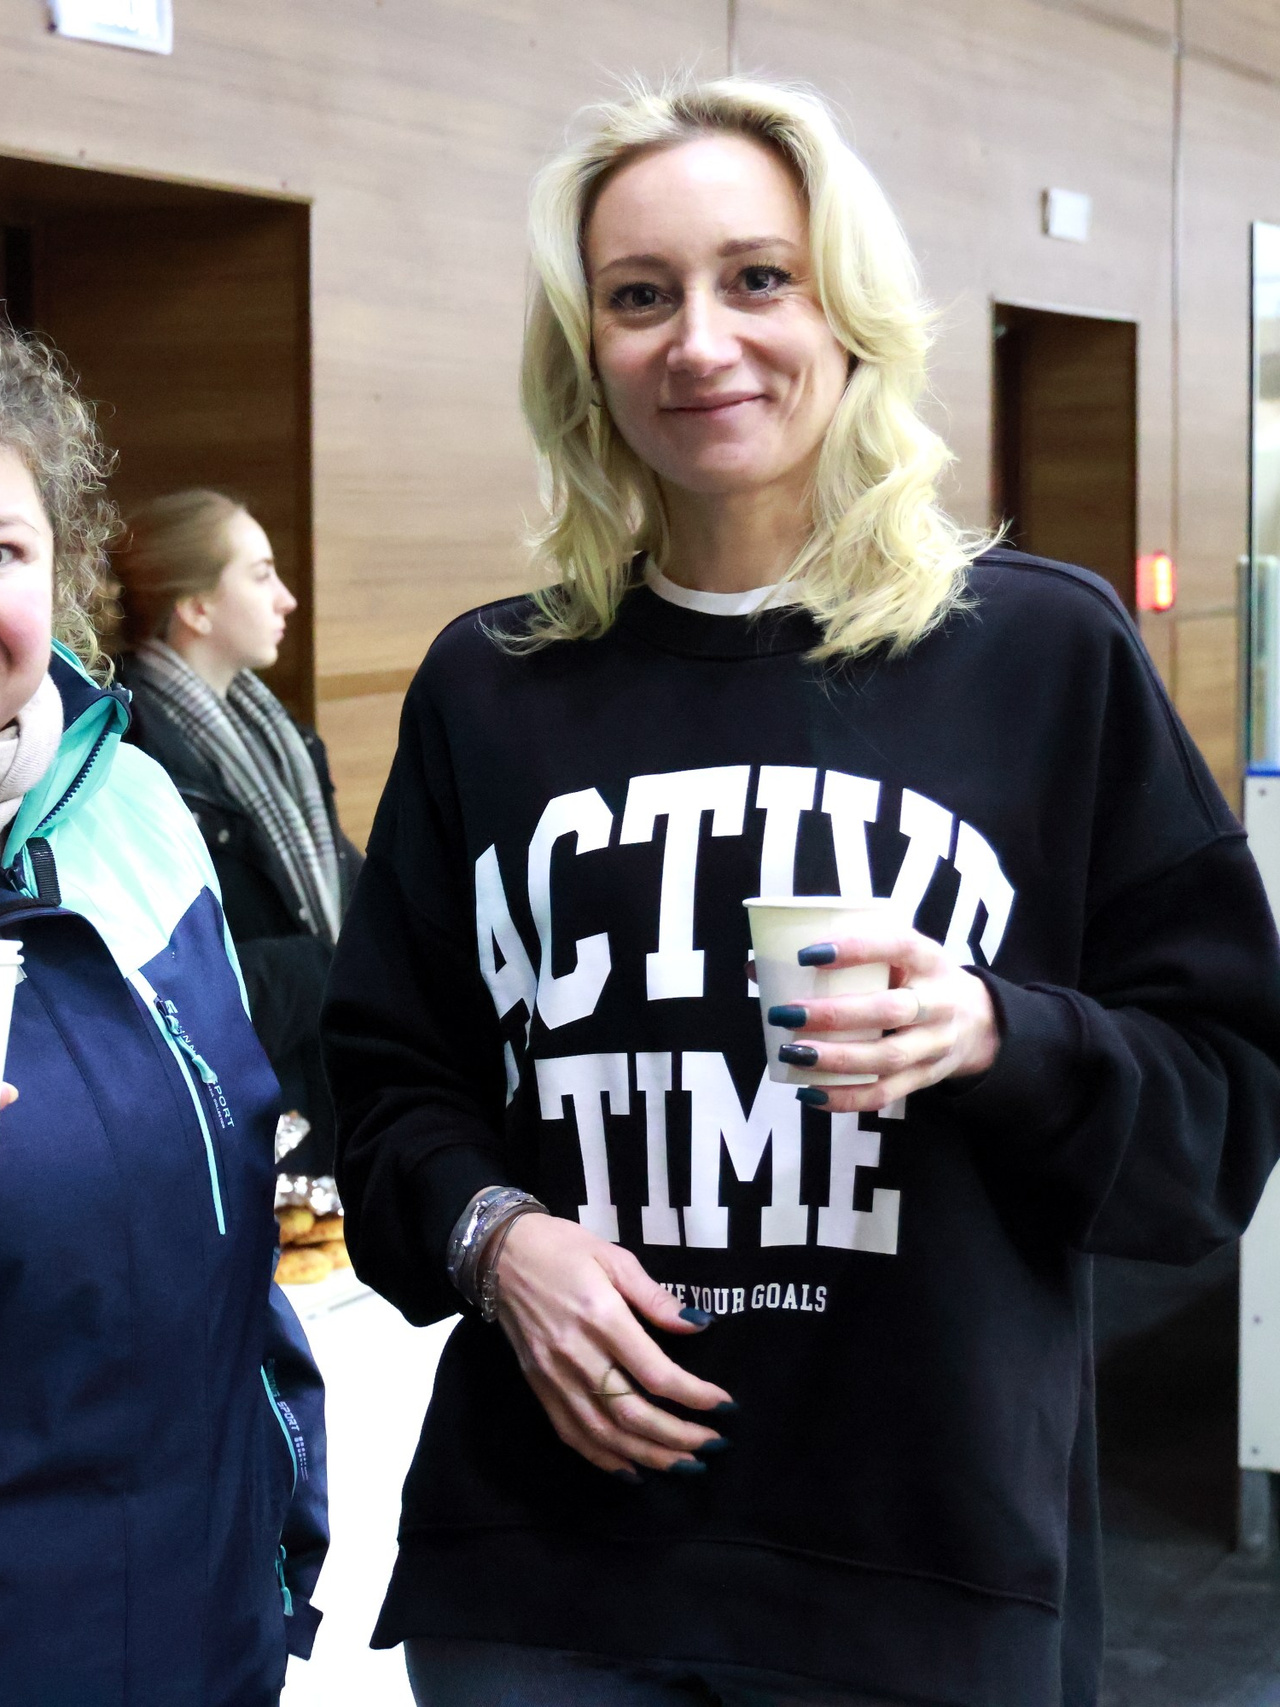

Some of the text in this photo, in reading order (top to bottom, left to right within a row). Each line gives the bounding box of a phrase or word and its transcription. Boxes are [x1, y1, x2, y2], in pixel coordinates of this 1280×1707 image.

[534, 1051, 906, 1255] TIME
[690, 1284, 745, 1315] YOUR
[751, 1282, 827, 1313] GOALS
[277, 1400, 300, 1432] SPORT
